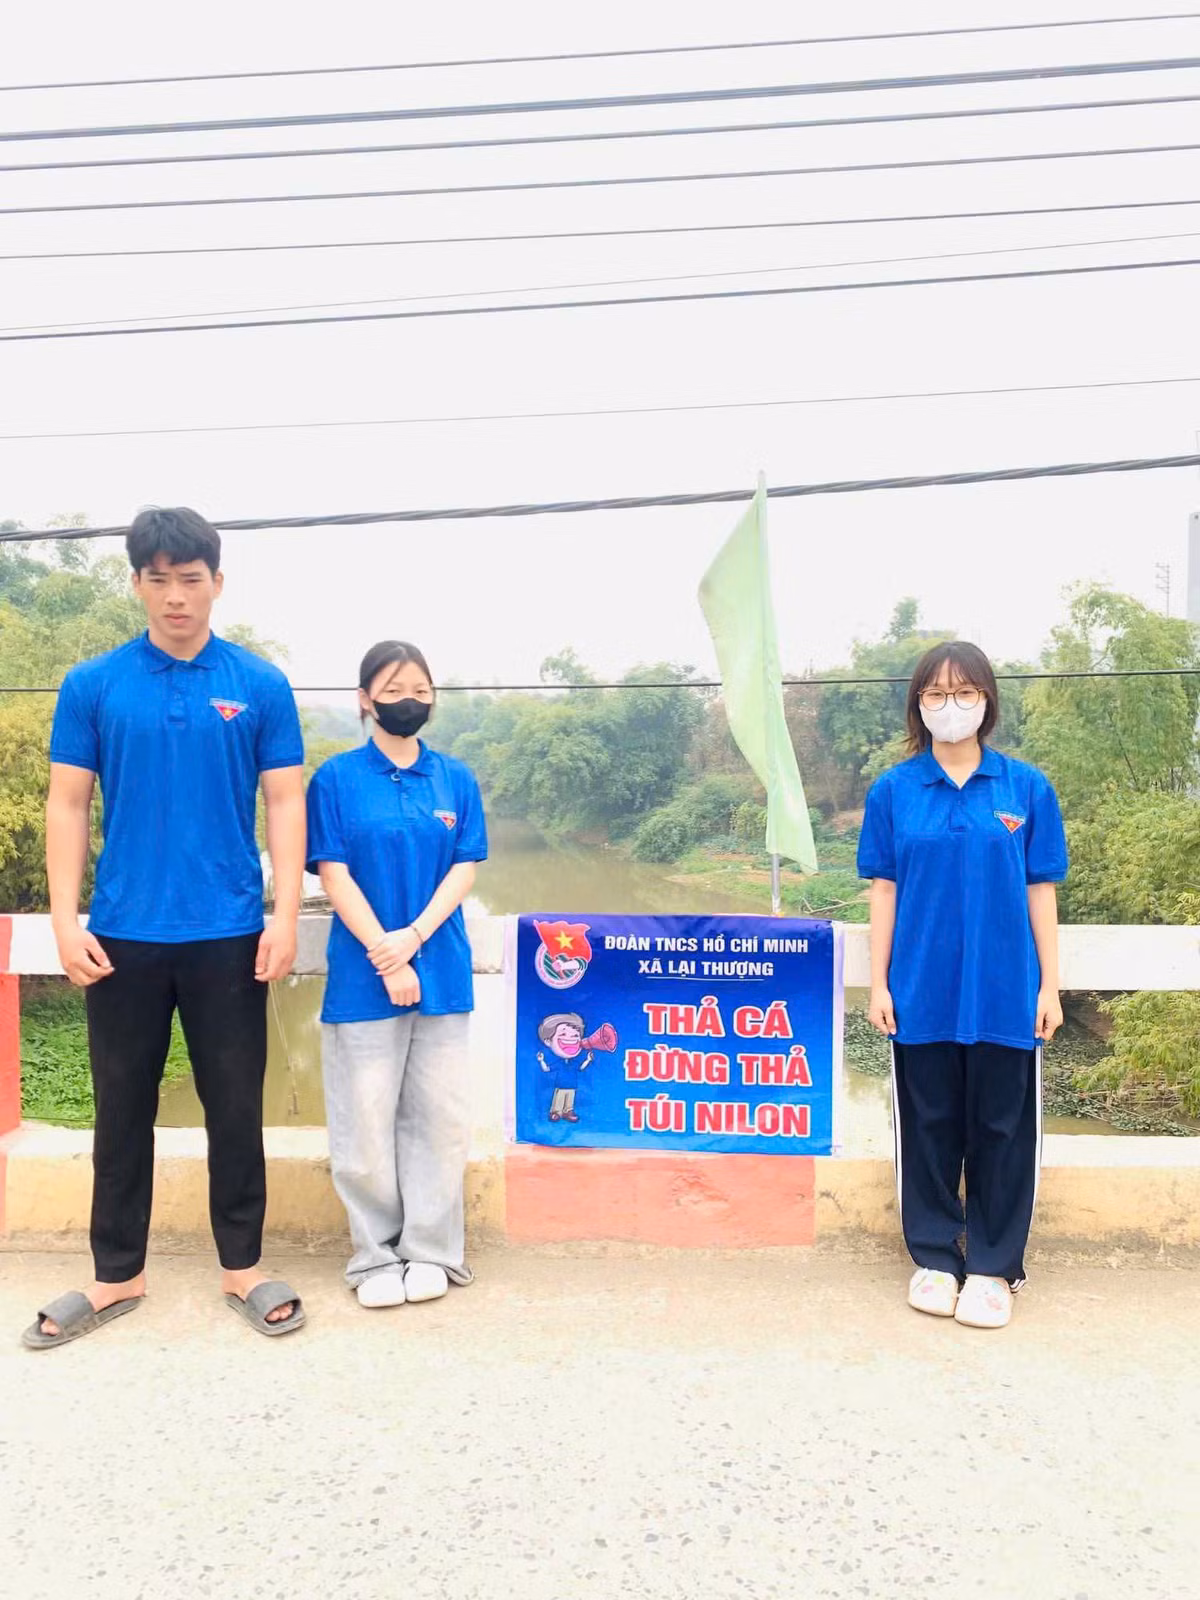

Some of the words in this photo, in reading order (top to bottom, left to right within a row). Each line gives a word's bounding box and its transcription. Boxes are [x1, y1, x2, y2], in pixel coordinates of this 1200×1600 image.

[604, 934, 650, 951] ĐOÀN
[655, 937, 698, 951] TNCS
[730, 936, 758, 953] CHÍ
[763, 938, 808, 953] MINH
[638, 957, 663, 974] XÃ
[668, 960, 696, 977] LẠI
[701, 960, 774, 978] THƯỢNG
[644, 996, 725, 1037] THẢ
[734, 1001, 793, 1038] CÁ
[624, 1044, 729, 1084] ĐỪNG
[738, 1045, 812, 1086] THẢ
[626, 1093, 685, 1132] TÚI
[695, 1101, 810, 1137] NILON
